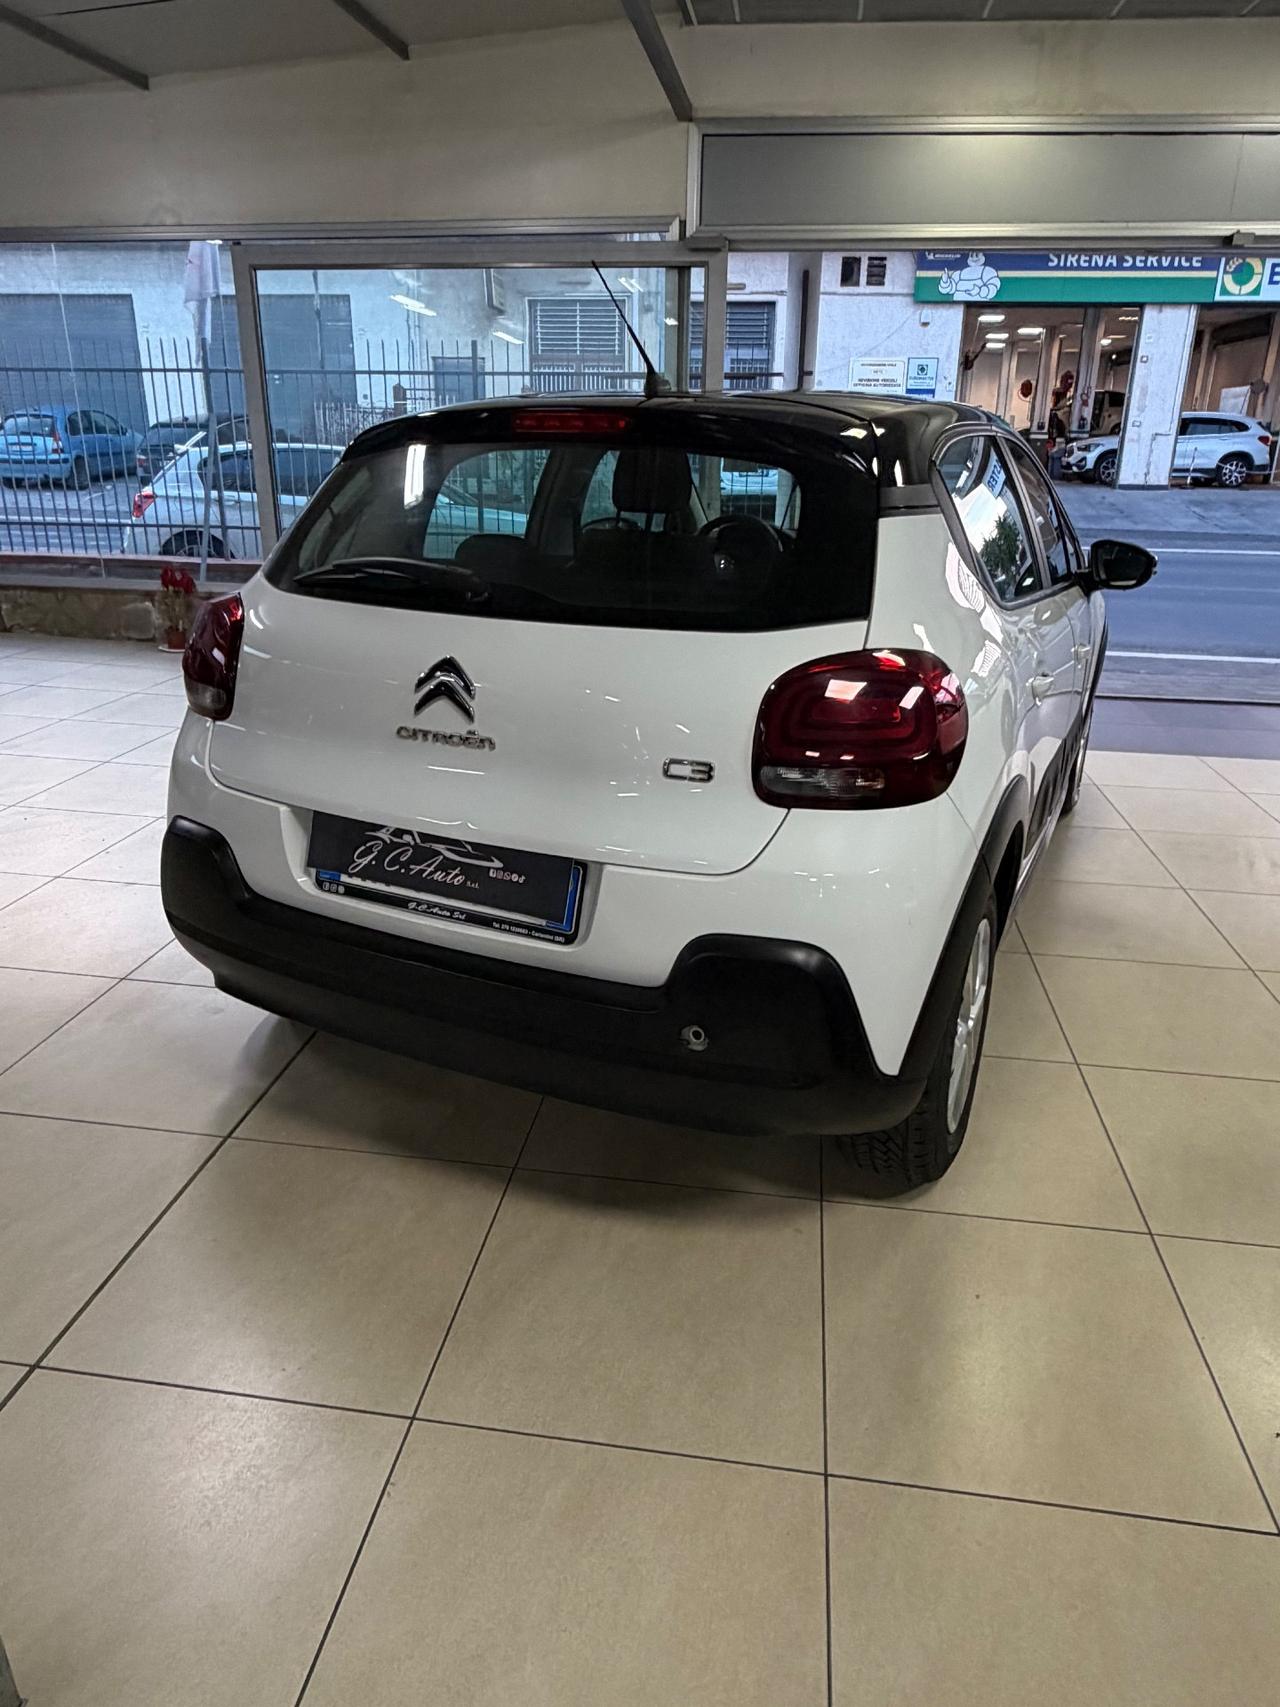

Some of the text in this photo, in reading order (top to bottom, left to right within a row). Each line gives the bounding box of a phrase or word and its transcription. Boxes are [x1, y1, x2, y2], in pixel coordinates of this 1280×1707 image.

[1048, 253, 1203, 267] SIRENA SERVICE
[663, 758, 714, 783] C3
